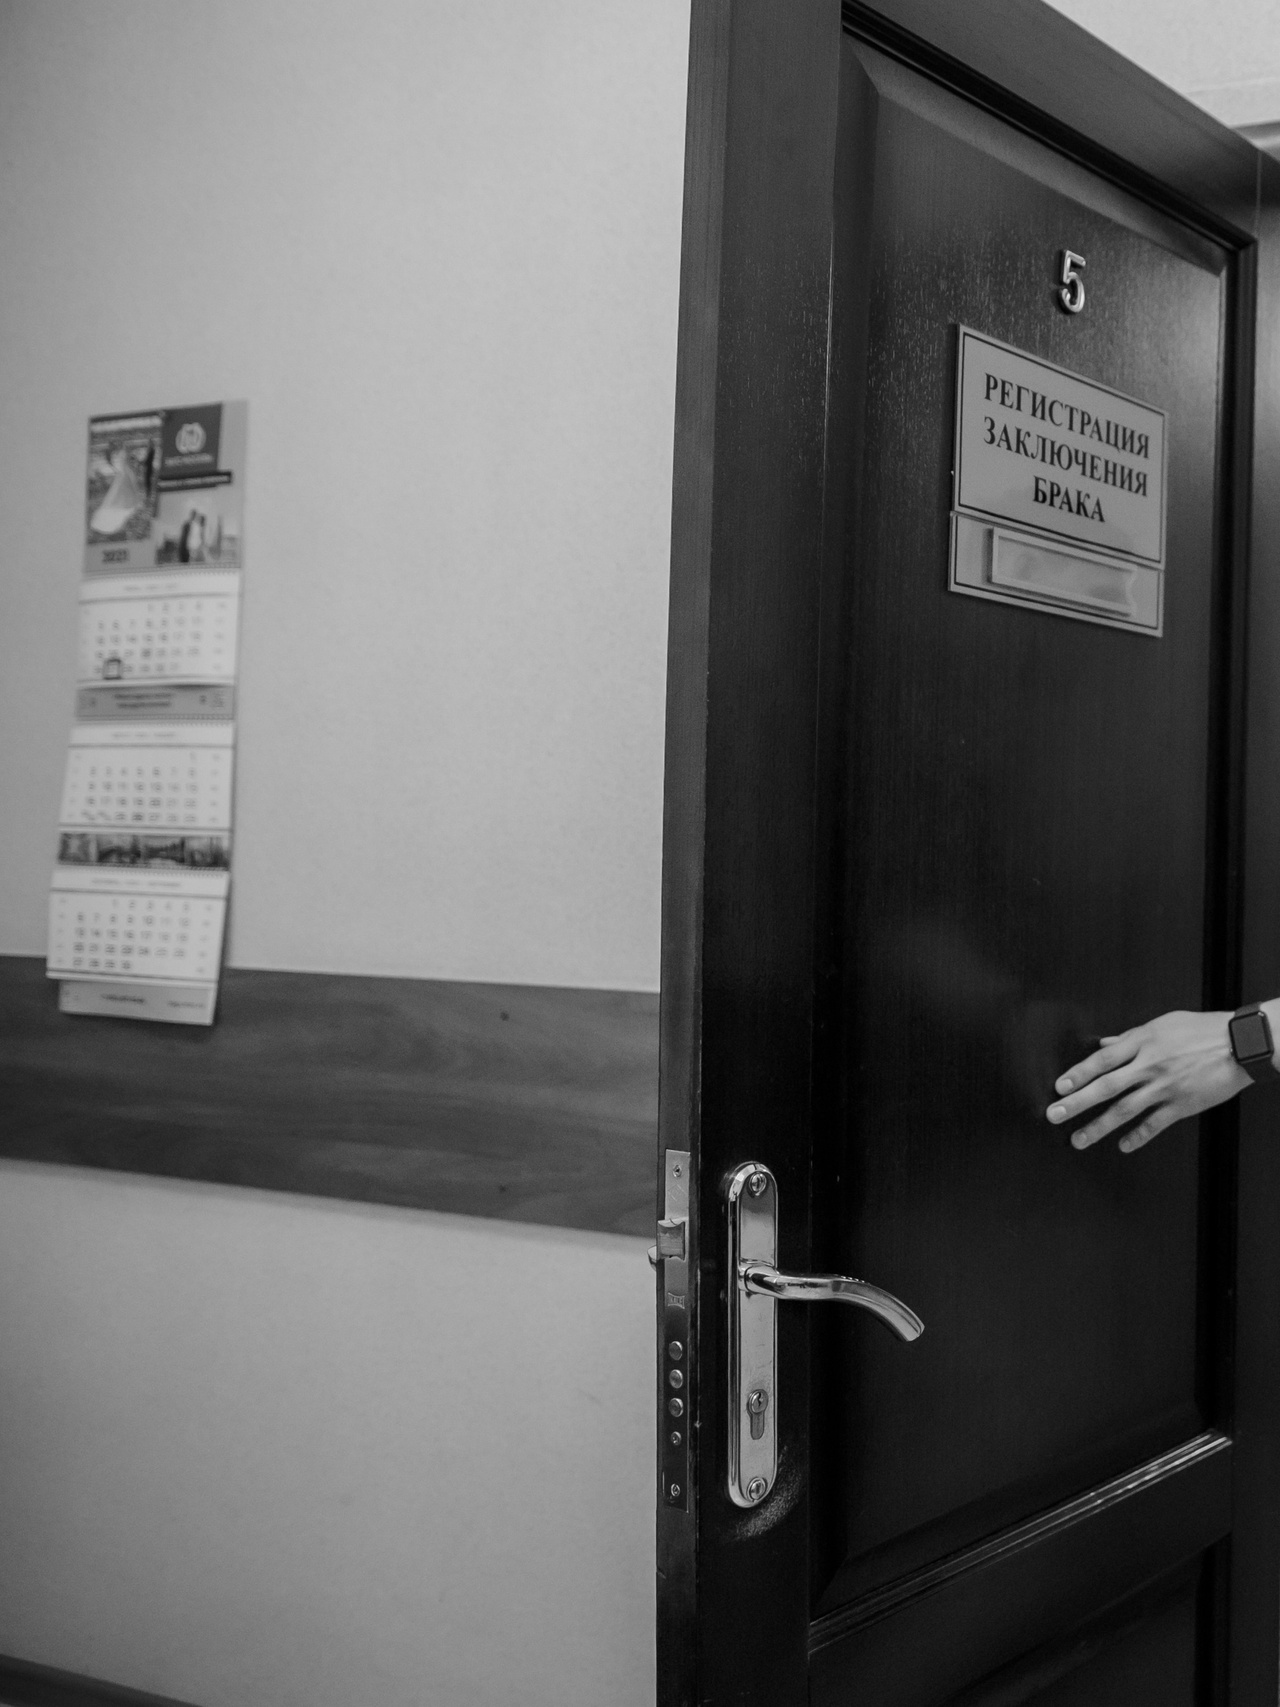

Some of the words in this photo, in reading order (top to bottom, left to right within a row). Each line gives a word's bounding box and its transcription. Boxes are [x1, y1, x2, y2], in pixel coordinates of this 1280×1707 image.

[1060, 250, 1087, 314] 5
[984, 372, 1150, 459] РЕГИСТРАЦИЯ
[983, 416, 1148, 497] ЗАКЛЮЧЕНИЯ
[1032, 475, 1106, 523] БРАКА
